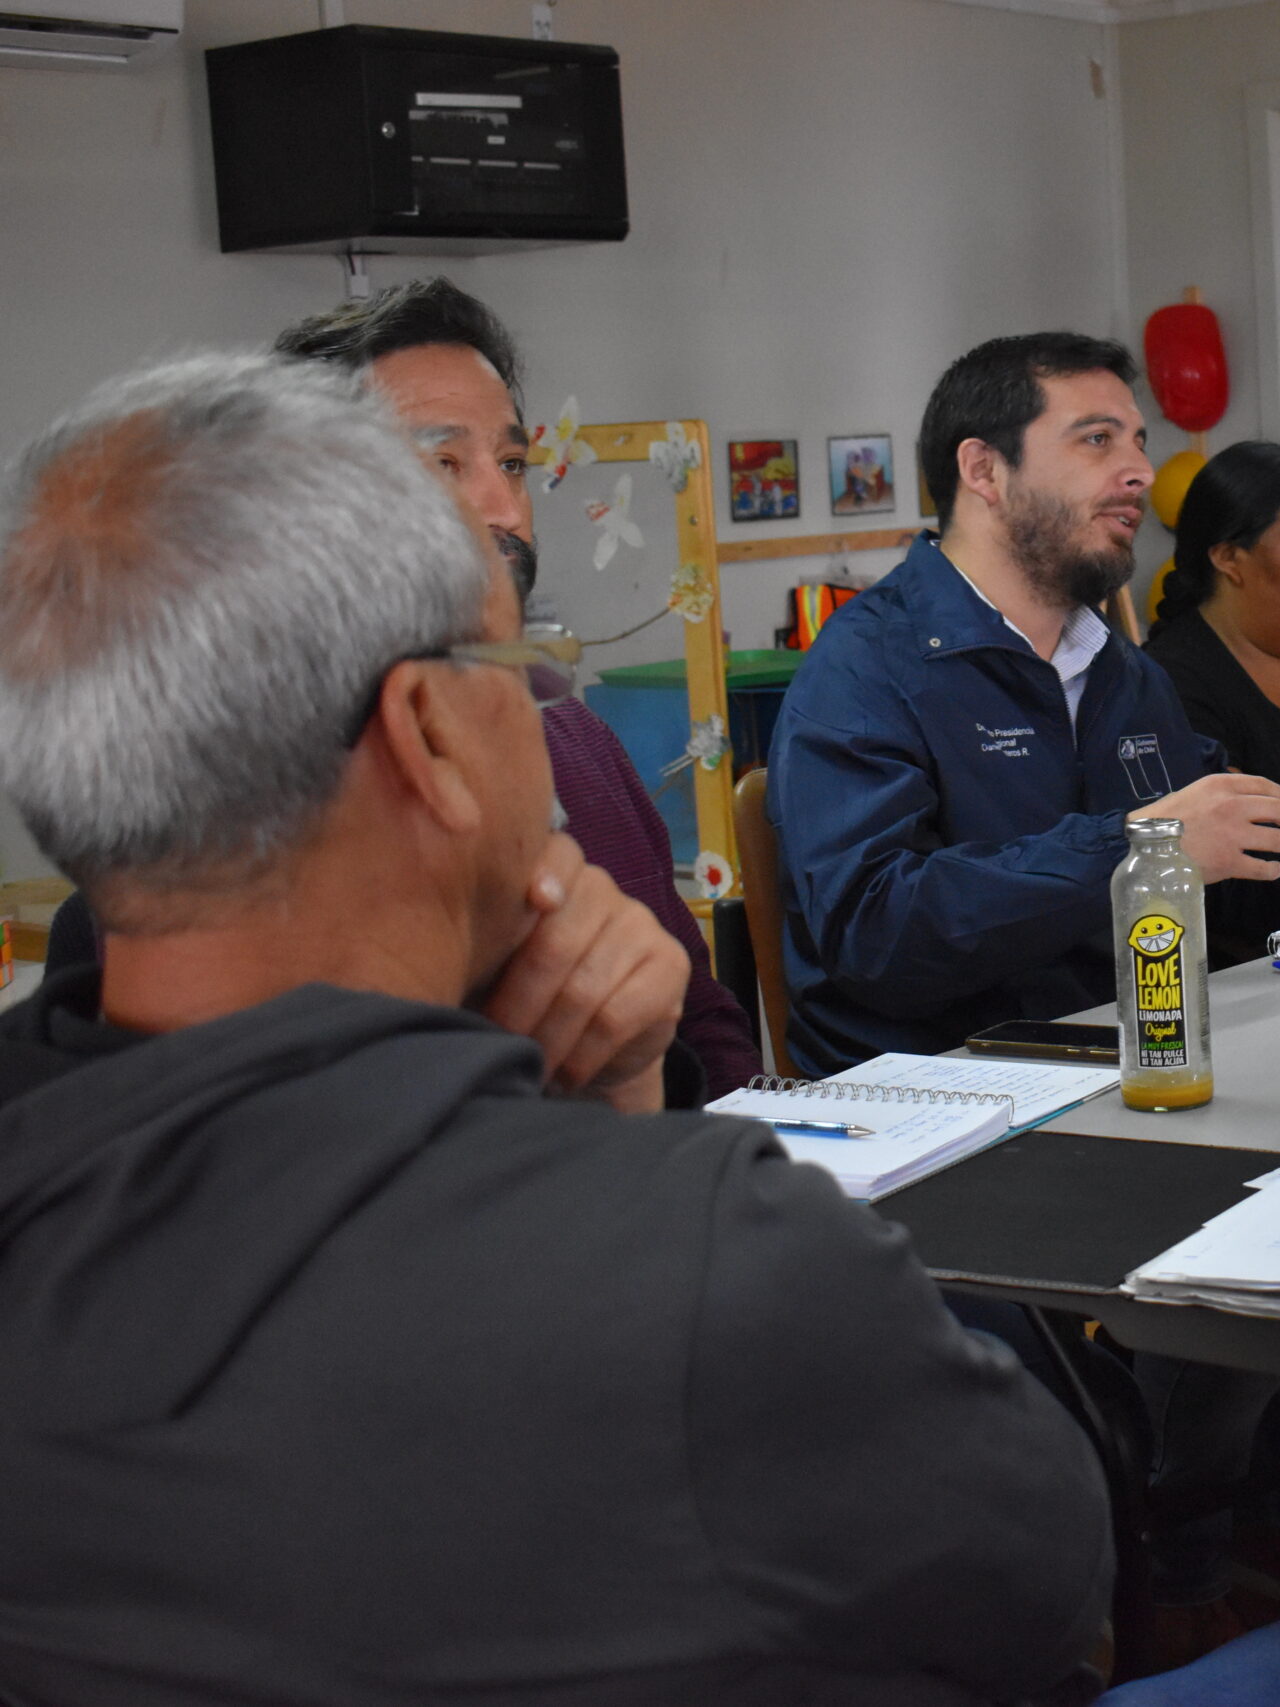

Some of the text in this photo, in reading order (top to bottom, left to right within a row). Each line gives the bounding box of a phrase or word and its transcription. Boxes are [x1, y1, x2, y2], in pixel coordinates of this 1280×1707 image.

[1136, 952, 1180, 987] LOVE
[1138, 985, 1181, 1010] LEMON
[1145, 1022, 1177, 1042] Original
[1149, 1050, 1162, 1058] TAN
[1163, 1049, 1185, 1058] DULCE
[1150, 1058, 1163, 1066] TAN
